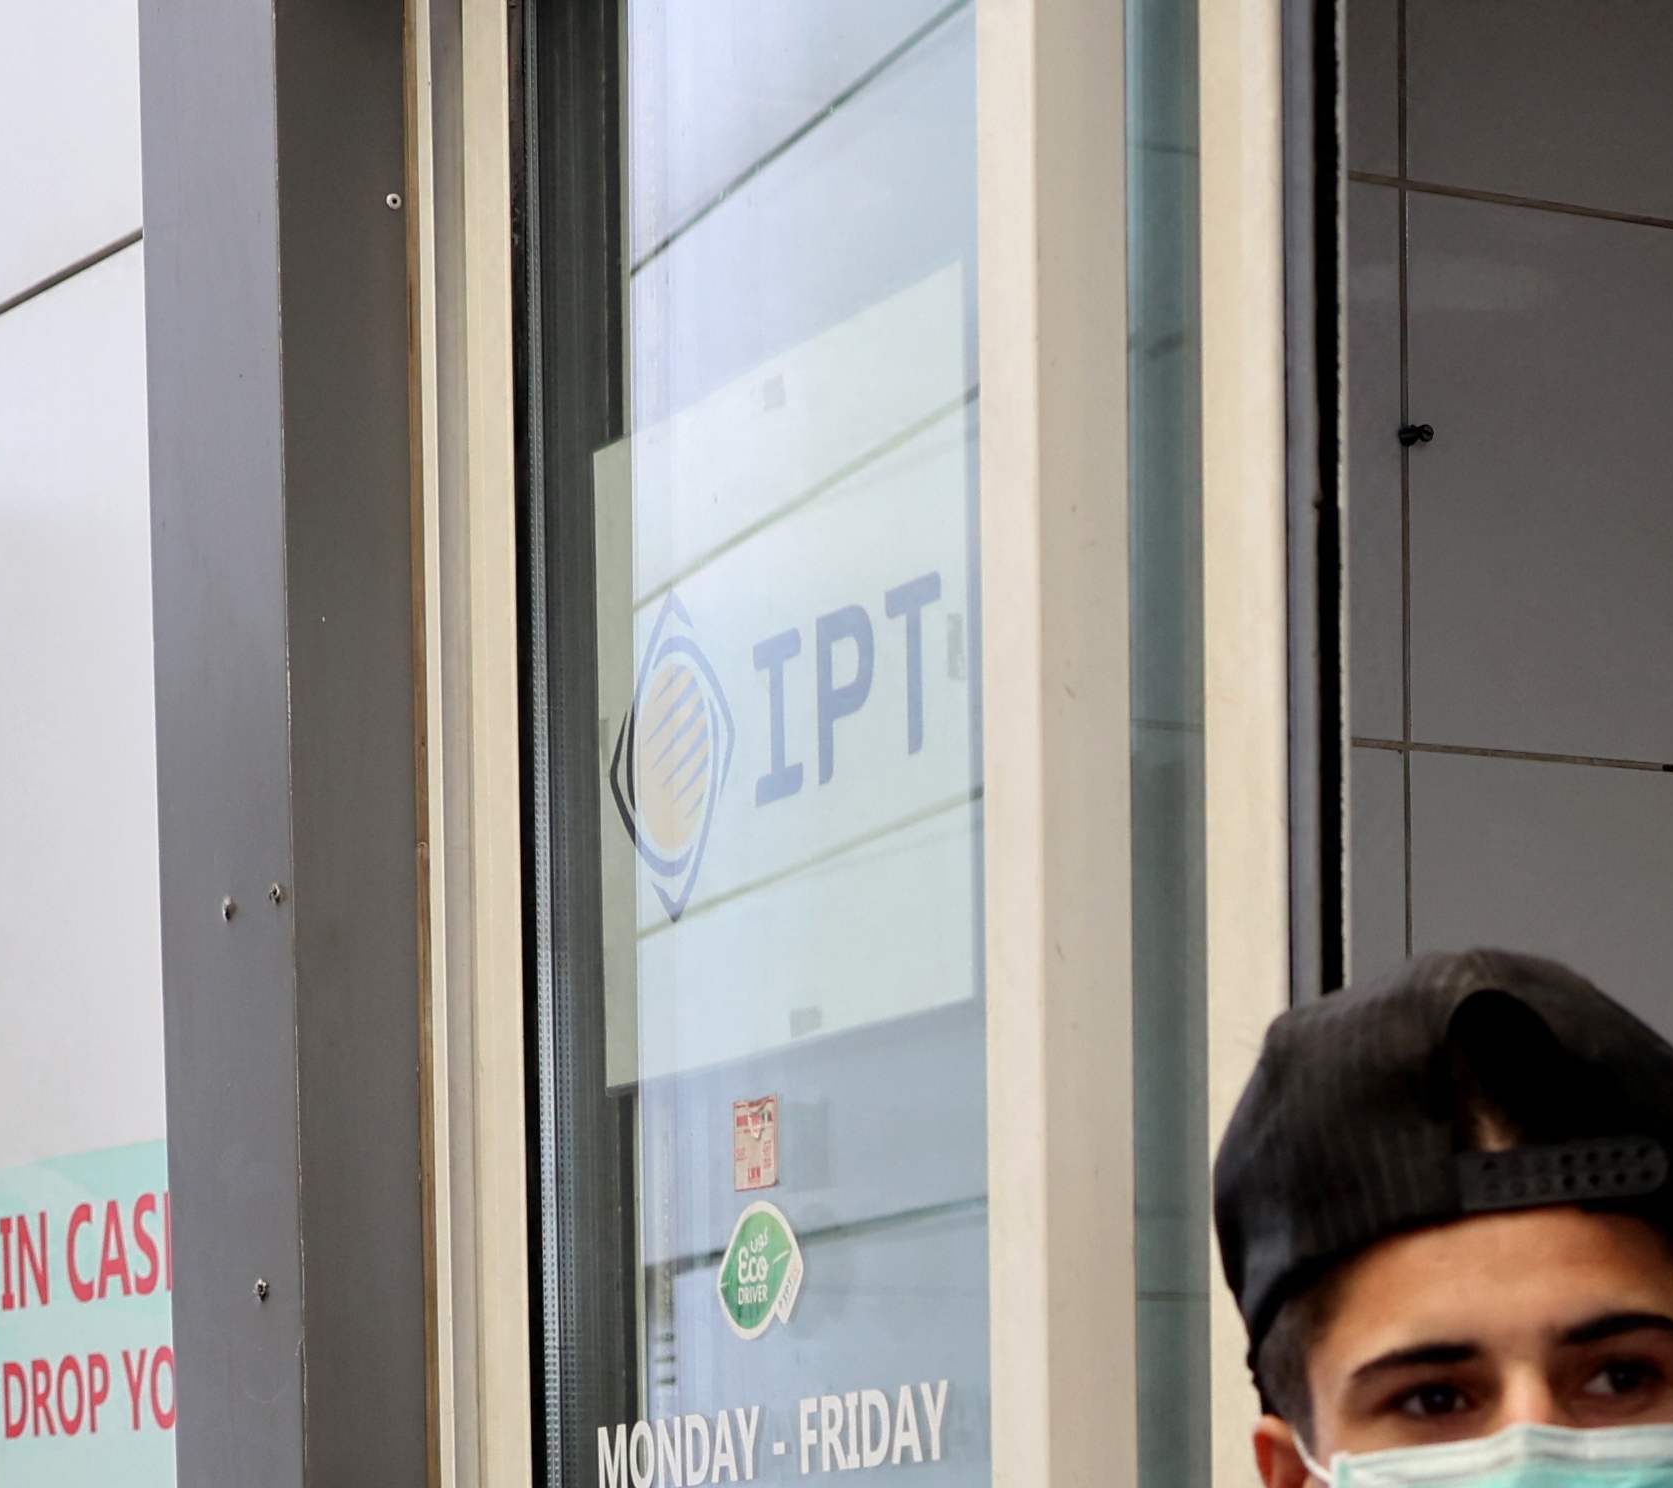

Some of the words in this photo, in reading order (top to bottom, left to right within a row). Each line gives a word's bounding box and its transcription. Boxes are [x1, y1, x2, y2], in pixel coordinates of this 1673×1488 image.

[752, 572, 941, 808] IPT
[0, 1210, 49, 1311] IN
[737, 1284, 768, 1305] DRIVER
[2, 1352, 111, 1440] DROP
[799, 1379, 948, 1475] FRIDAY
